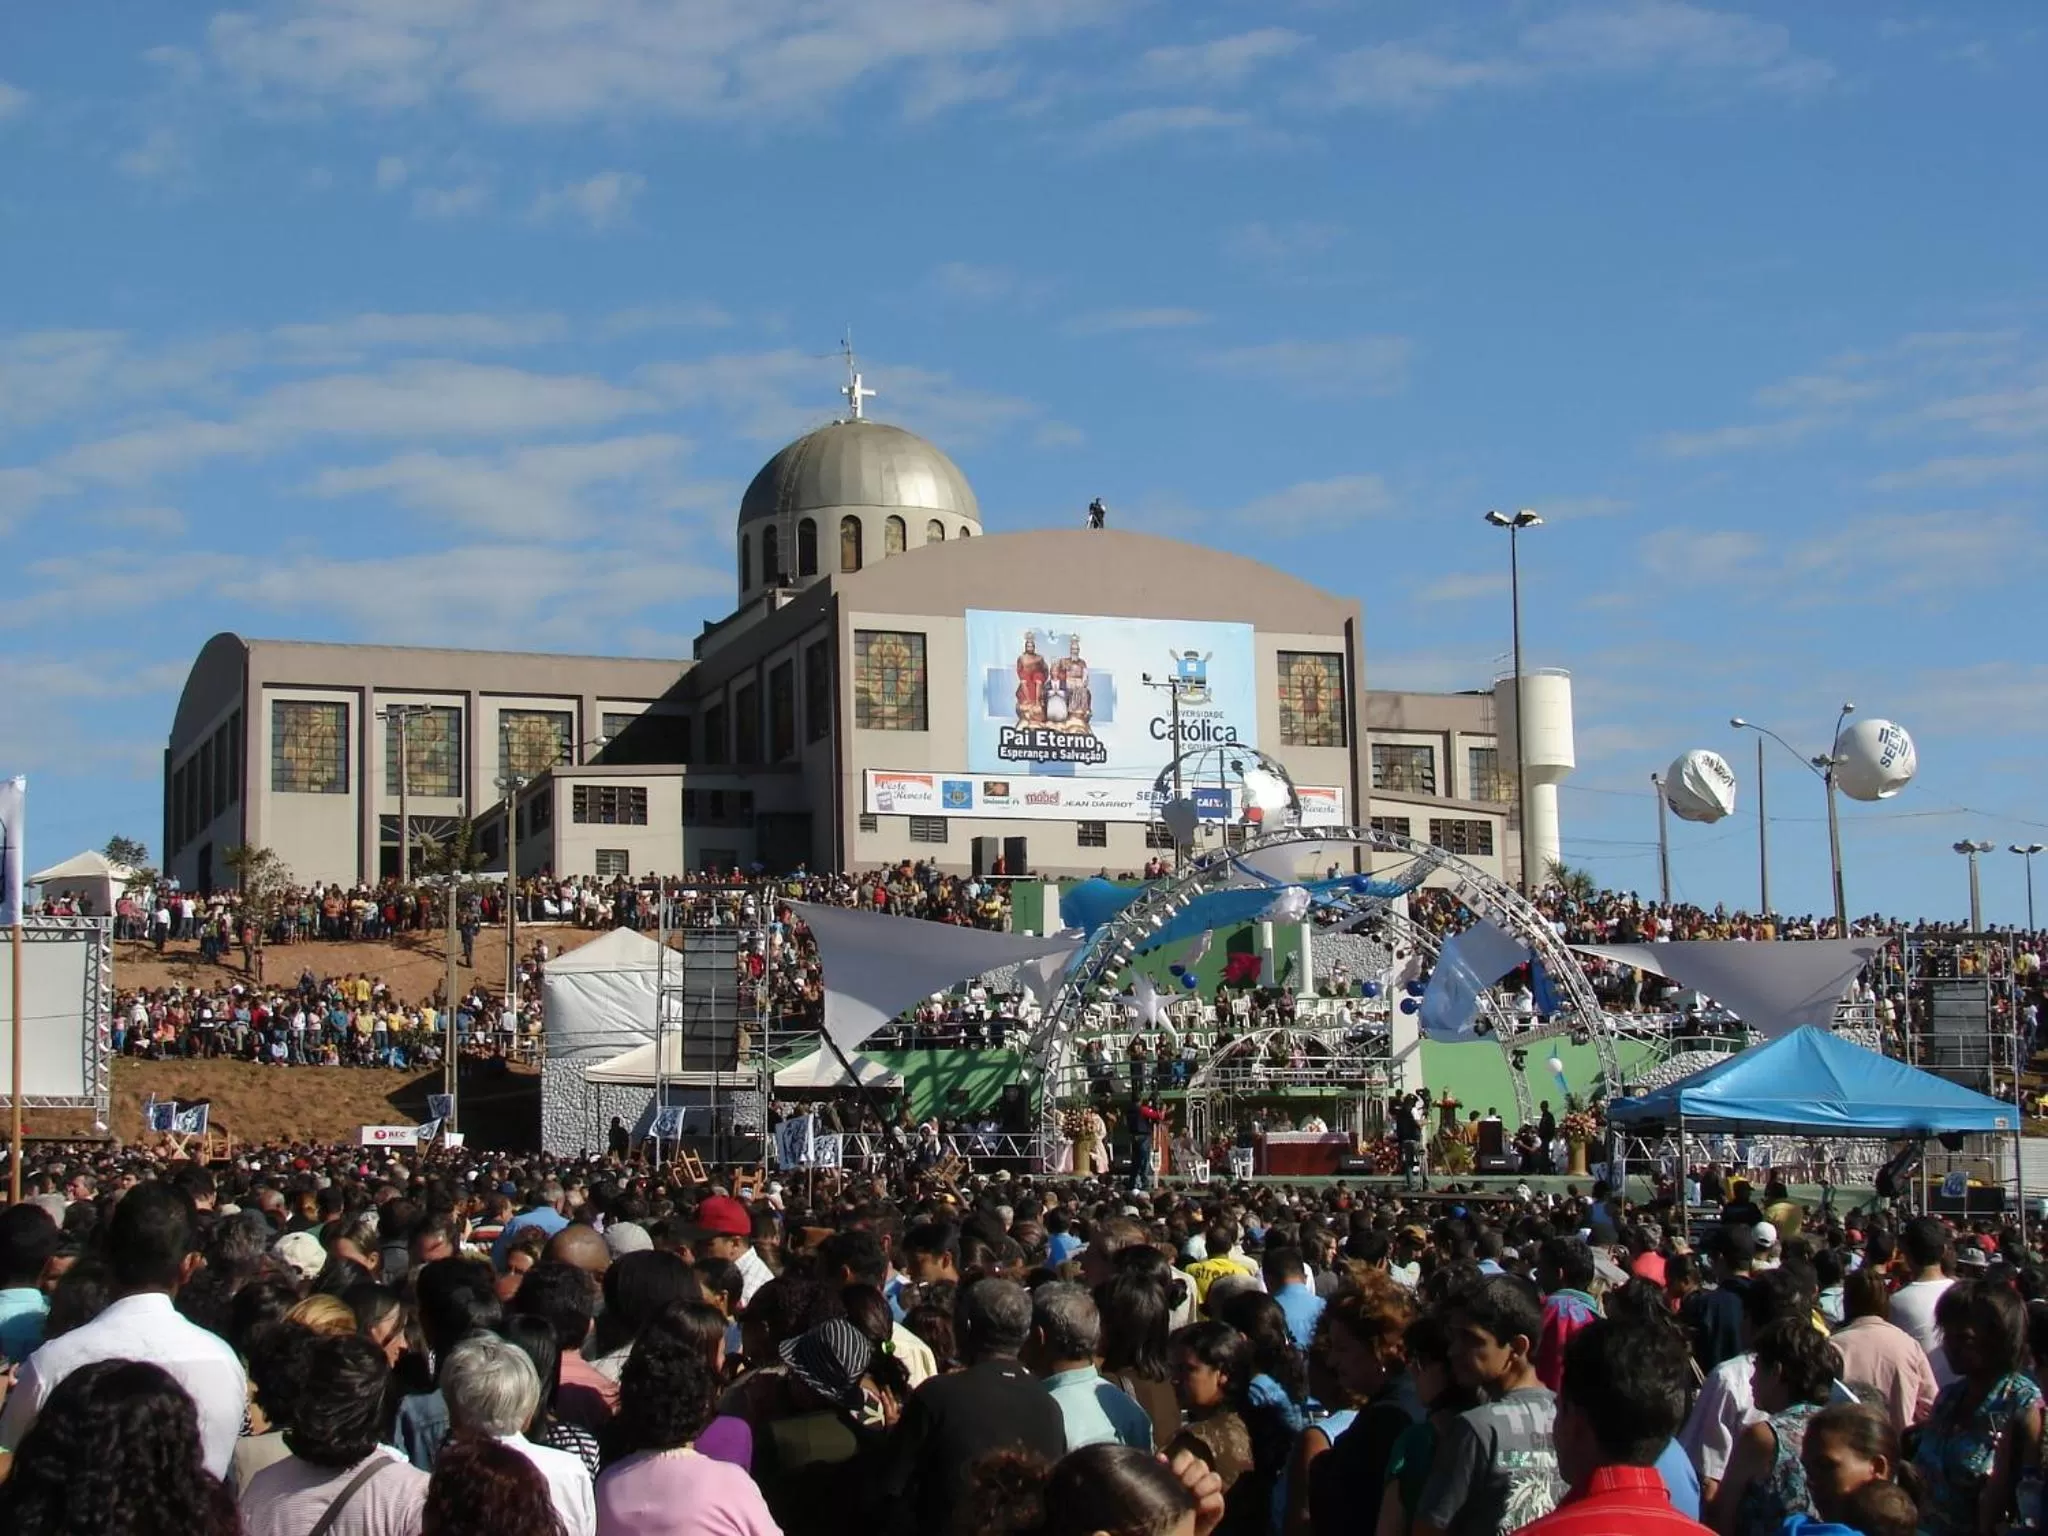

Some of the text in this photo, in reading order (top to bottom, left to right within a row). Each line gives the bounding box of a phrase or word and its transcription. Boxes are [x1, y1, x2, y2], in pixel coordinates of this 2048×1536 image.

[1002, 728, 1100, 751] Pai Eterno,
[1149, 716, 1237, 742] Católica
[1000, 746, 1049, 762] Esperança
[1060, 748, 1105, 763] Salvação!
